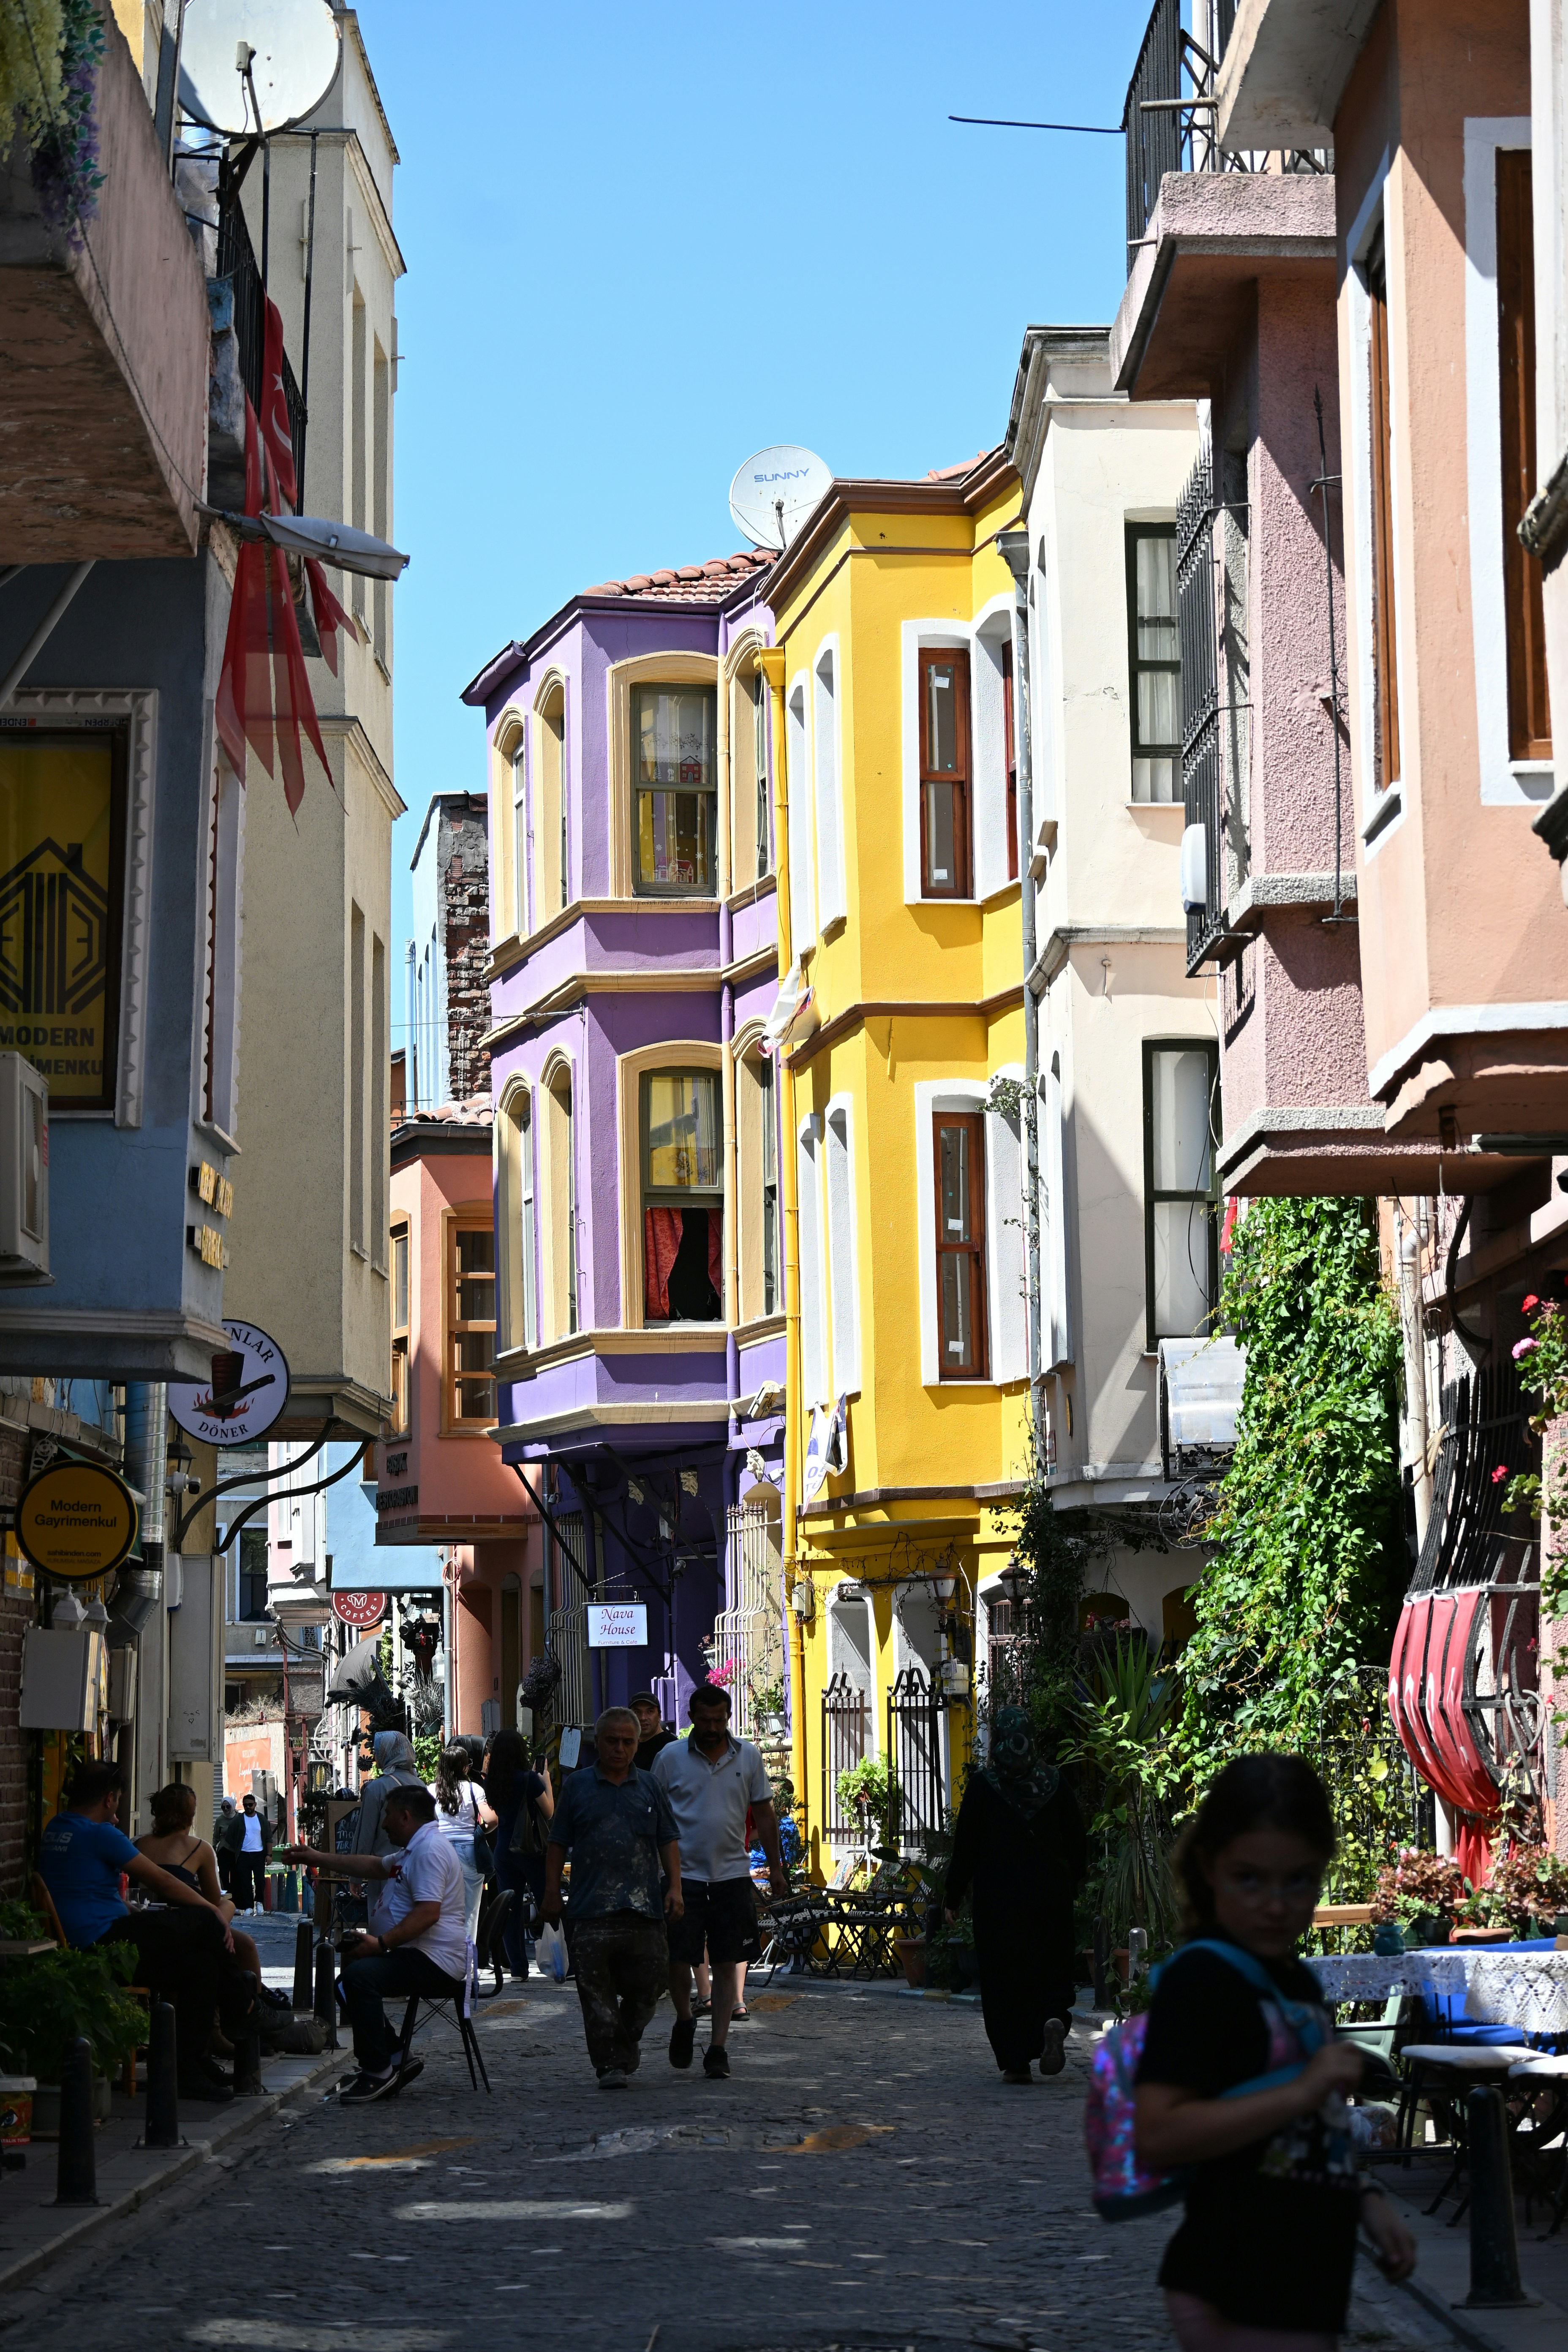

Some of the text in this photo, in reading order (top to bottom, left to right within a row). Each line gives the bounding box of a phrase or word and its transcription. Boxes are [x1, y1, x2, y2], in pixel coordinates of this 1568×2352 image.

[754, 468, 809, 482] SUNNY
[0, 1026, 94, 1046] MODERN
[198, 1421, 249, 1438] DÖNER
[386, 1452, 408, 1476] BAŞAK
[376, 1485, 418, 1510] RESTORASYON
[51, 1500, 101, 1512] Modern
[35, 1514, 117, 1528] Gayrimenkul
[340, 1604, 377, 1620] COFFEE
[601, 1606, 634, 1621] Nava
[600, 1622, 636, 1635] House
[242, 1748, 257, 1758] WELCOME
